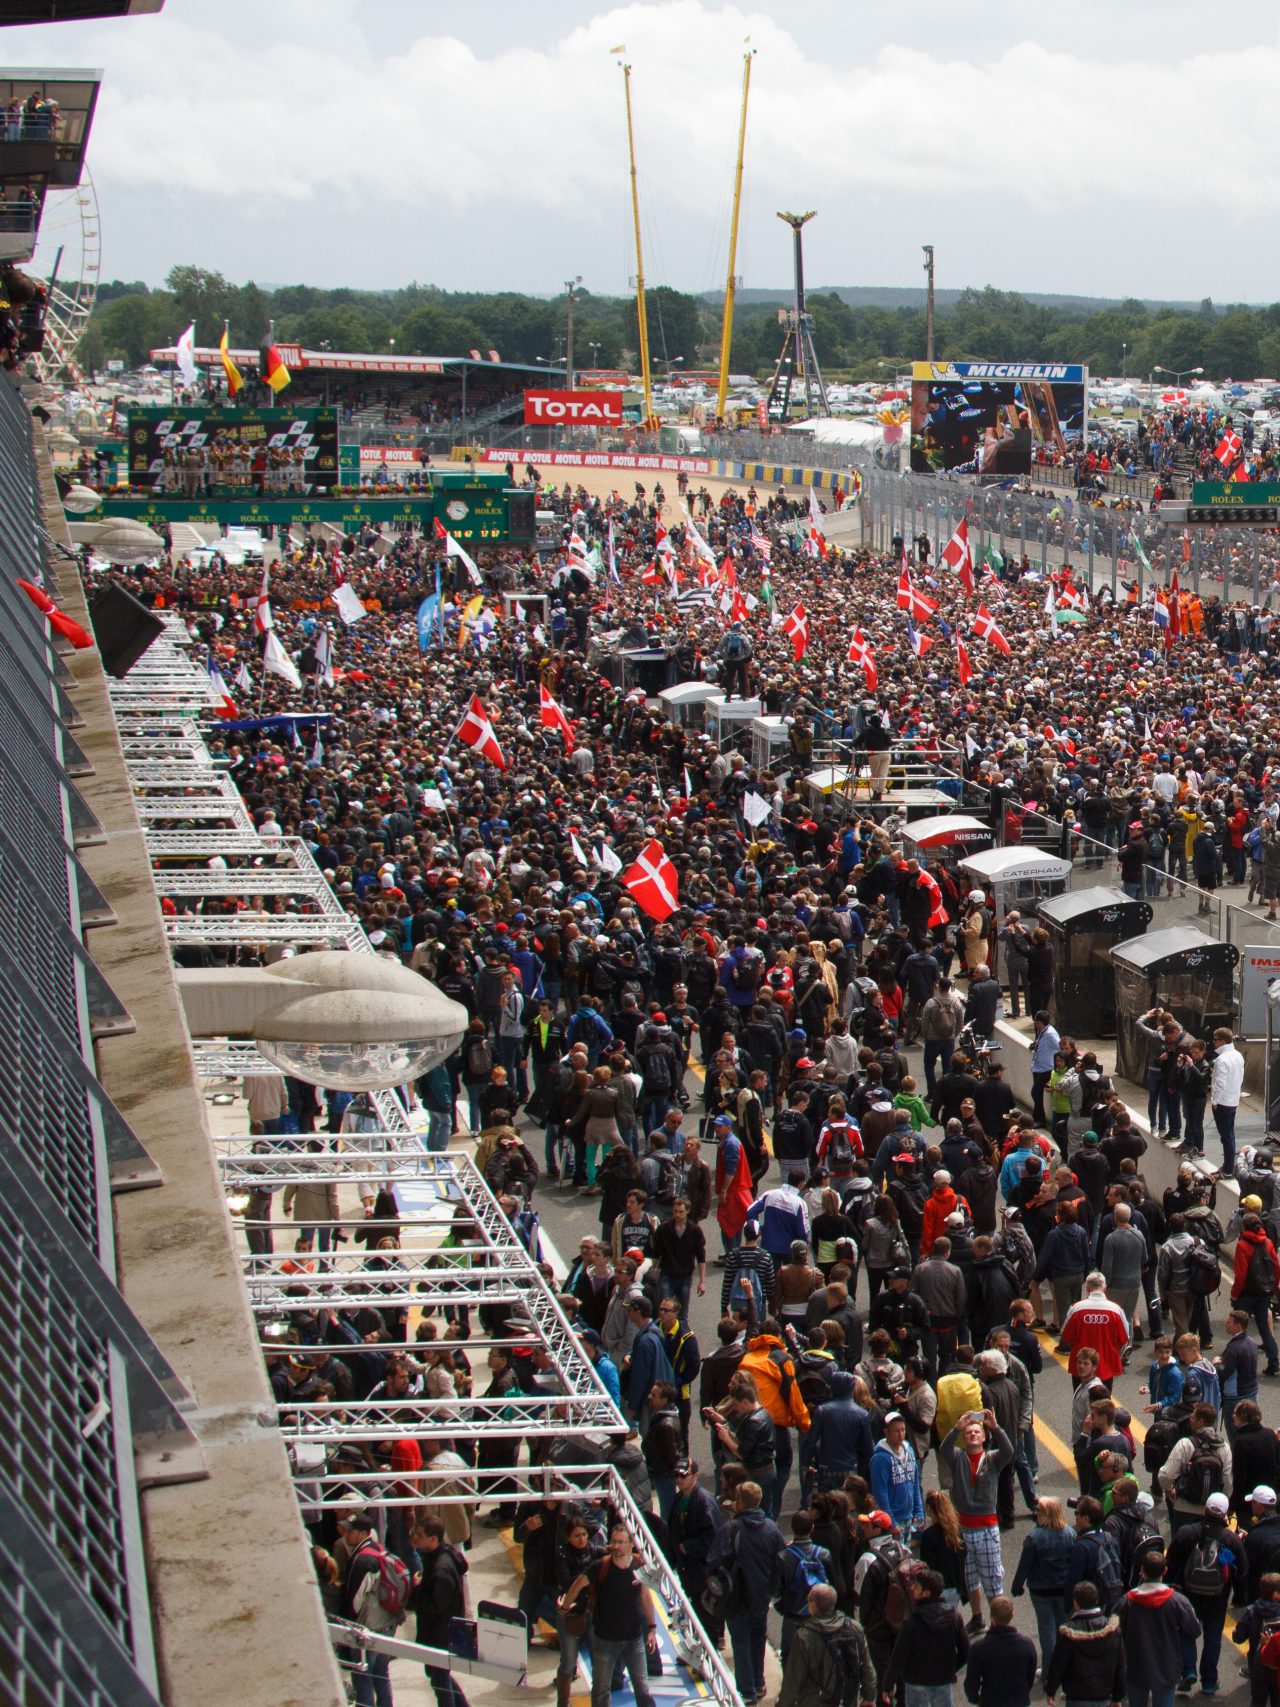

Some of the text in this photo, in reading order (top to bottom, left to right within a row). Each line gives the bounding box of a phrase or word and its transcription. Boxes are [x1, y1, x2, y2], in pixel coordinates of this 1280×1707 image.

[967, 365, 1068, 379] MICHELIN
[528, 396, 621, 418] TOTAL
[215, 427, 239, 440] 24
[385, 450, 413, 461] MOTUL
[488, 451, 519, 462] MOTUL
[523, 453, 551, 463] MOTUL
[554, 454, 582, 465] MOTUL
[584, 455, 609, 466] MOTUL
[612, 456, 636, 467] MOTUL
[637, 457, 660, 468] MOTUL
[661, 459, 679, 470] MOTUL
[1211, 496, 1244, 504] ROLEX
[954, 833, 992, 841] NISSAN
[1002, 867, 1063, 877] CATERHAM
